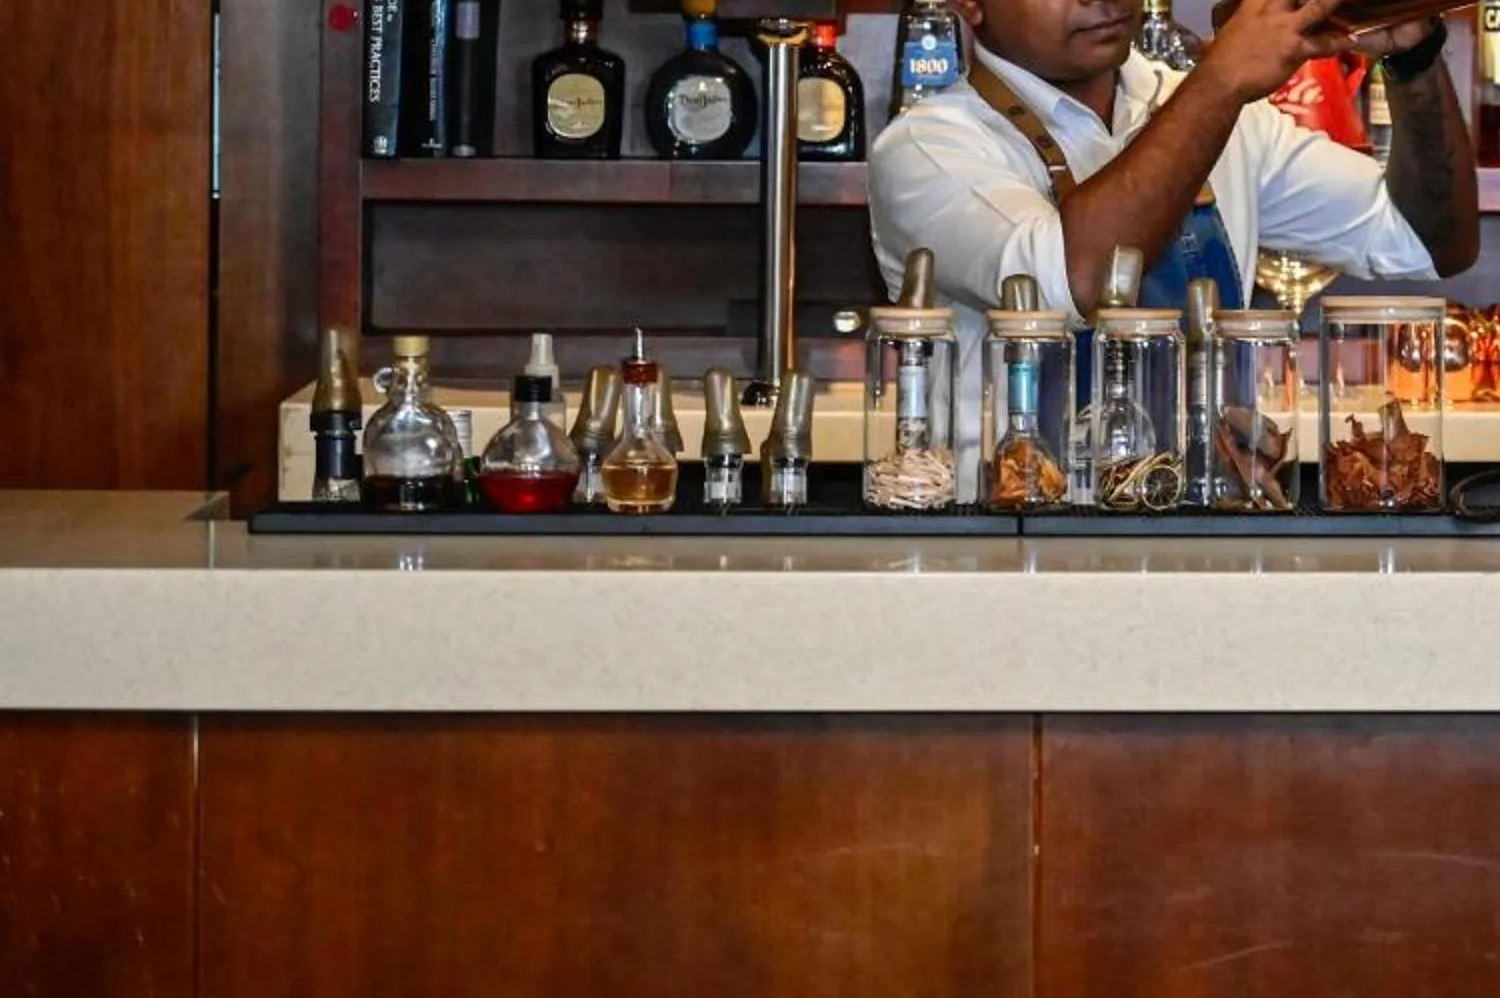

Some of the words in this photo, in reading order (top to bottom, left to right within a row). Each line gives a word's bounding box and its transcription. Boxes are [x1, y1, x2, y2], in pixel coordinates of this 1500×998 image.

[371, 5, 384, 34] BEST
[369, 38, 384, 103] PRACTICES
[909, 58, 949, 74] 1800
